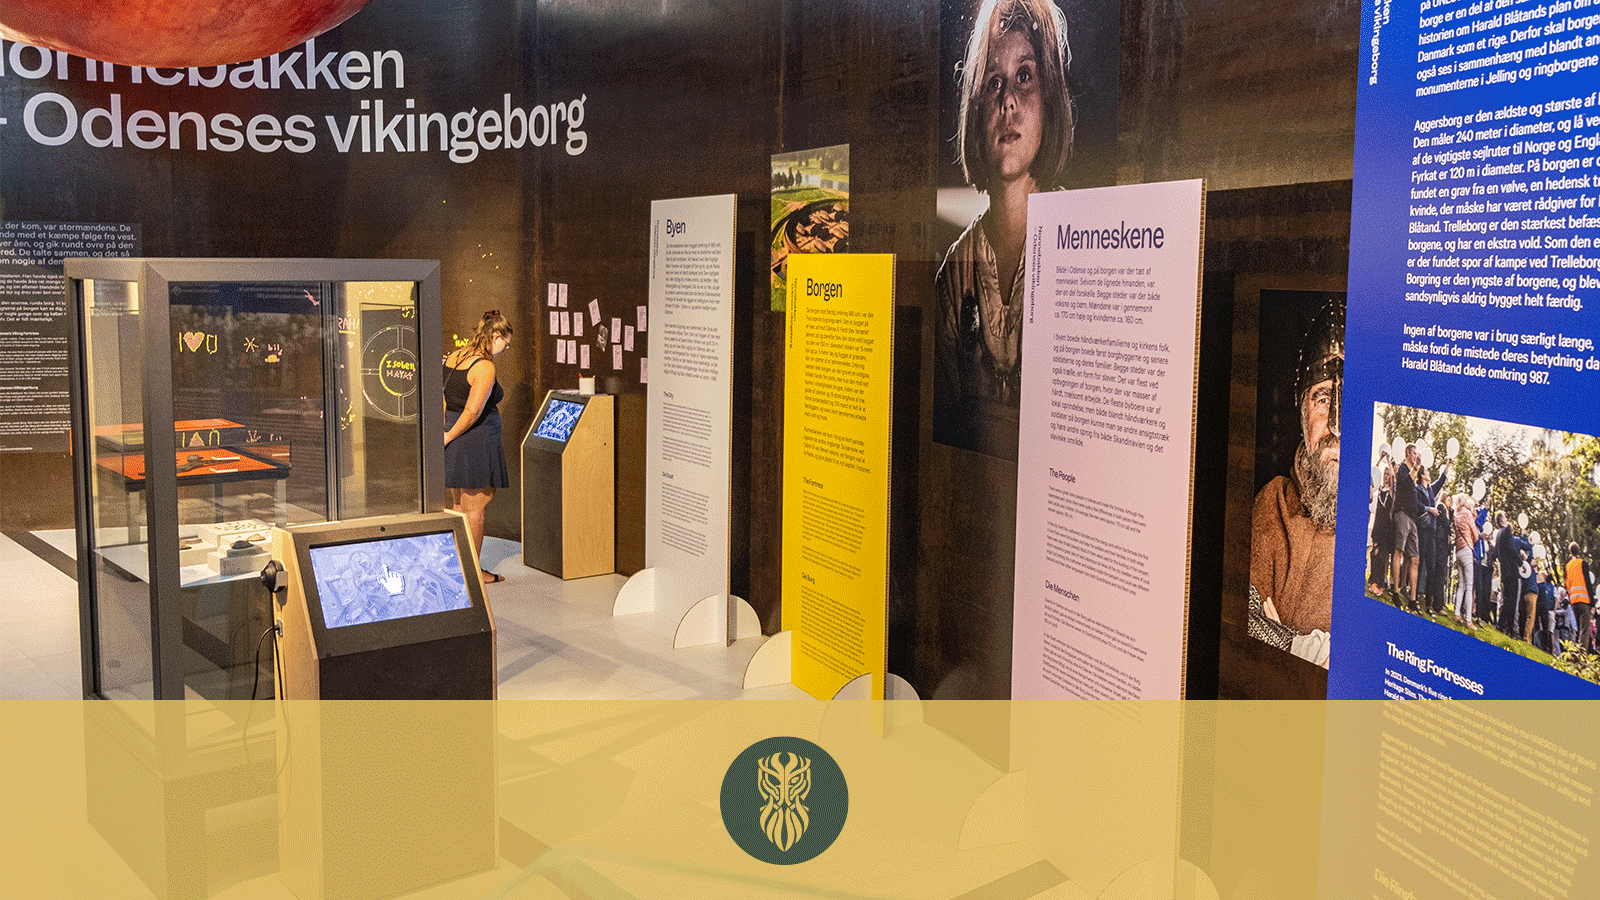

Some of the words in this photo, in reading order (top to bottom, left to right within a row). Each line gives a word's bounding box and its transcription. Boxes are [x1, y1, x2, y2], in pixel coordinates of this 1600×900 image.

[1418, 44, 1455, 63] Danmark
[1456, 42, 1475, 55] som
[1476, 38, 1487, 50] et
[1488, 34, 1509, 49] rige.
[1510, 25, 1543, 43] Derfor
[1544, 18, 1566, 36] skal
[1416, 77, 1480, 97] monumenterne
[1480, 73, 1484, 86] i
[1485, 69, 1517, 85] Jelling
[1518, 67, 1532, 81] og
[1534, 55, 1599, 77] ringborgene
[1414, 115, 1463, 134] Aggersborg
[1464, 114, 1474, 124] er
[1475, 109, 1493, 123] den
[1494, 105, 1528, 120] ældste
[1529, 104, 1543, 116] og
[1544, 97, 1583, 113] største
[1584, 92, 1597, 108] af
[24, 92, 316, 153] Odenses
[325, 94, 588, 164] vikingeborg
[1413, 136, 1430, 149] Den
[1431, 132, 1455, 146] måler
[1456, 129, 1474, 144] 240
[1475, 128, 1503, 141] meter
[1504, 125, 1508, 137] i
[1509, 121, 1554, 137] diameter,
[1557, 119, 1572, 131] og
[1573, 114, 1584, 129] lå
[1586, 116, 1600, 127] ve
[1412, 152, 1422, 166] af
[1421, 152, 1433, 165] de
[1434, 149, 1472, 166] vigtigste
[1472, 145, 1512, 162] sejlruter
[1512, 141, 1523, 155] til
[1524, 140, 1556, 155] Norge
[1558, 139, 1572, 152] og
[1574, 132, 1600, 149] Engl
[22, 222, 41, 230] kom,
[59, 224, 118, 232] stormændene.
[48, 232, 80, 241] kæmpe
[81, 232, 101, 241] følge
[666, 219, 686, 237] Byen
[1057, 221, 1165, 249] Menneskene
[1409, 220, 1442, 234] Blåtand.
[1443, 219, 1488, 234] Trelleborg
[1489, 221, 1500, 231] er
[1500, 218, 1520, 231] den
[1521, 216, 1567, 230] stærkest
[47, 241, 59, 249] gik
[12, 257, 35, 266] nogle
[807, 278, 842, 301] Borgen
[1406, 272, 1441, 288] Borgring
[1442, 276, 1452, 285] er
[1453, 273, 1470, 286] den
[1471, 275, 1503, 289] yngste
[1504, 273, 1516, 287] af
[1516, 274, 1561, 291] borgene,
[1562, 278, 1577, 292] og
[1405, 290, 1460, 306] sandsynligvis
[1461, 291, 1487, 308] aldrig
[1489, 292, 1523, 309] bygget
[1524, 293, 1544, 307] helt
[1546, 293, 1584, 312] færdig.
[1403, 323, 1426, 338] Ingen
[1427, 324, 1437, 337] af
[1437, 325, 1473, 342] borgene
[1474, 331, 1490, 341] var
[1491, 329, 1495, 342] i
[1496, 329, 1519, 347] brug
[1520, 332, 1556, 349] særligt
[1558, 333, 1594, 352] længe,
[1403, 340, 1429, 354] måske
[1430, 342, 1450, 356] fordi
[1450, 344, 1462, 357] de
[1463, 346, 1500, 361] mistede
[1501, 348, 1529, 364] deres
[1531, 351, 1584, 372] betydning
[1585, 356, 1600, 370] da
[1402, 357, 1429, 371] Harald
[1430, 360, 1462, 375] Blåtand
[1463, 363, 1487, 378] døde
[1488, 367, 1528, 386] omkring
[1529, 370, 1550, 385] 987.
[1049, 468, 1058, 478] The
[1059, 470, 1075, 483] People
[1387, 642, 1404, 660] The
[1405, 650, 1427, 673] Ring
[1427, 659, 1484, 695] Fortresses
